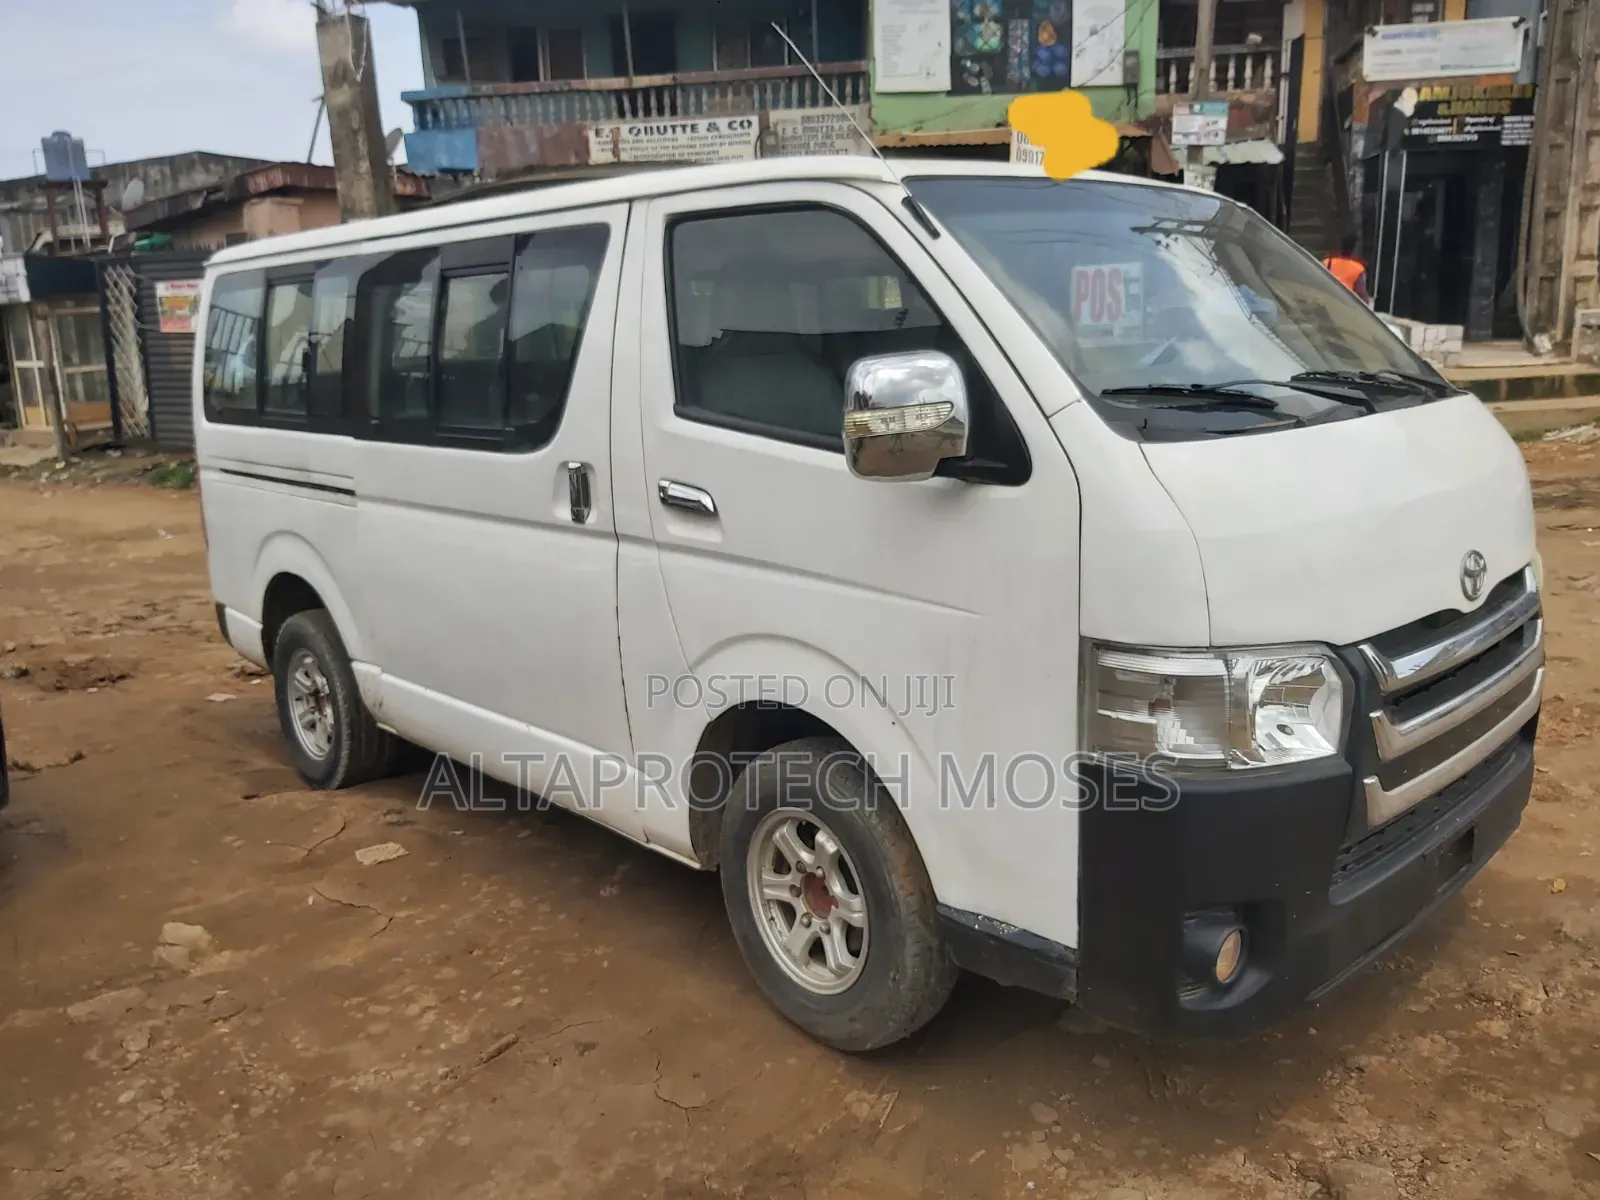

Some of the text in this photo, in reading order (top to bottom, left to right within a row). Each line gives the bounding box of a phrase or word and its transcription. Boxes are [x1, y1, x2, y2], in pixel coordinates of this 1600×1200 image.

[628, 123, 700, 137] OBUTTE
[707, 121, 720, 133] &
[728, 119, 753, 131] CO
[1074, 267, 1123, 324] POS
